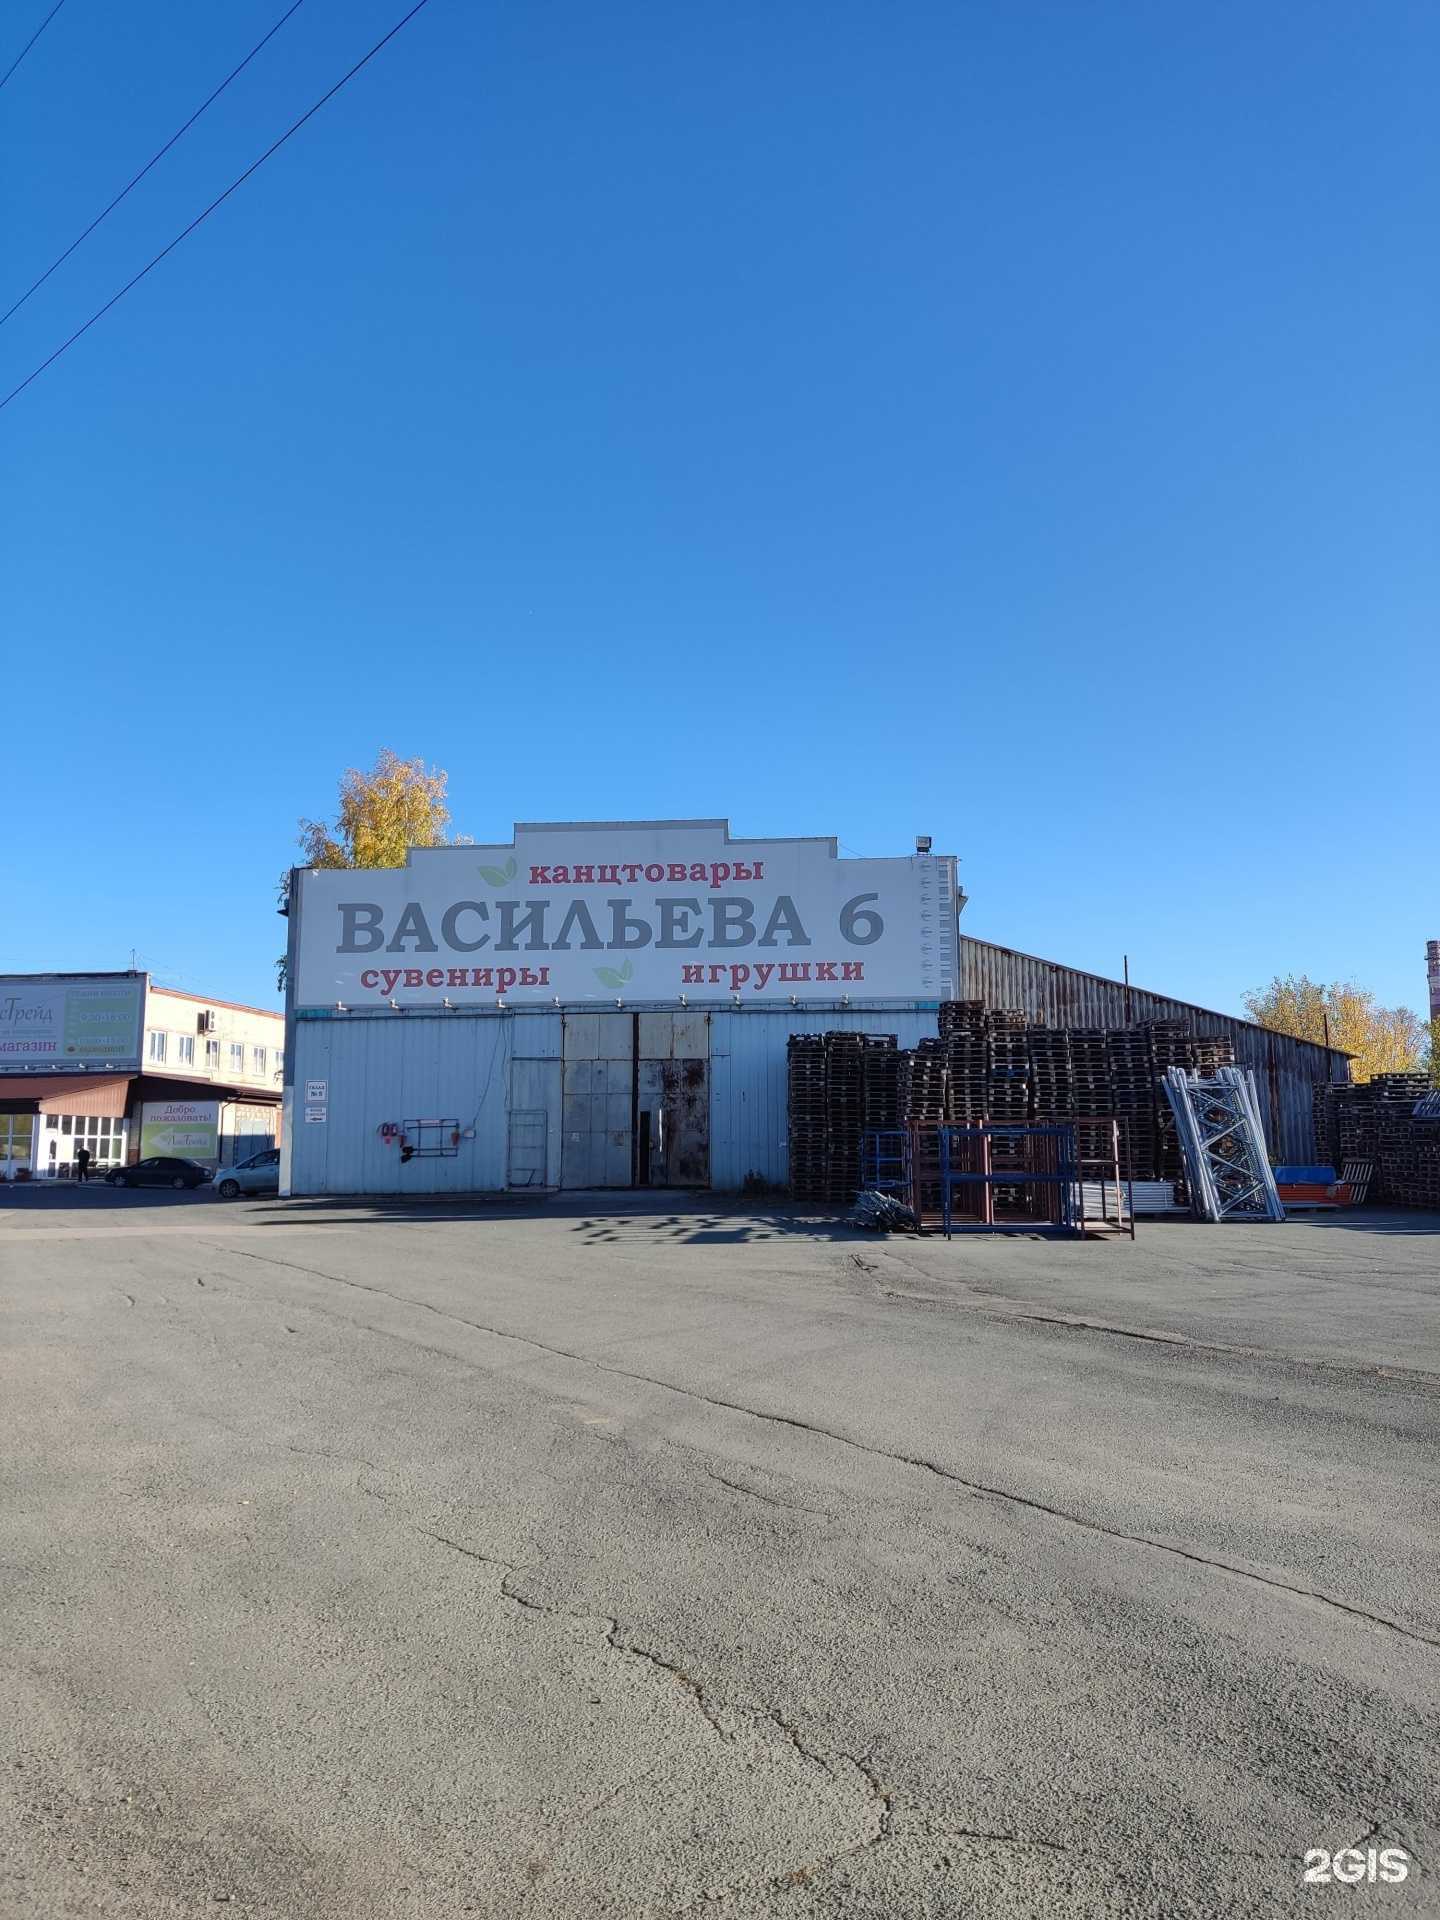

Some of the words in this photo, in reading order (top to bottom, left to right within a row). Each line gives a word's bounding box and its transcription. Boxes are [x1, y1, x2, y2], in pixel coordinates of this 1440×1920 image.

[529, 861, 764, 888] канцтовары
[336, 896, 811, 953] ВАСИЛЬЕВА
[839, 892, 884, 946] 6
[360, 967, 550, 996] сувениры
[682, 962, 864, 990] игрушки
[164, 1104, 197, 1115] Добро
